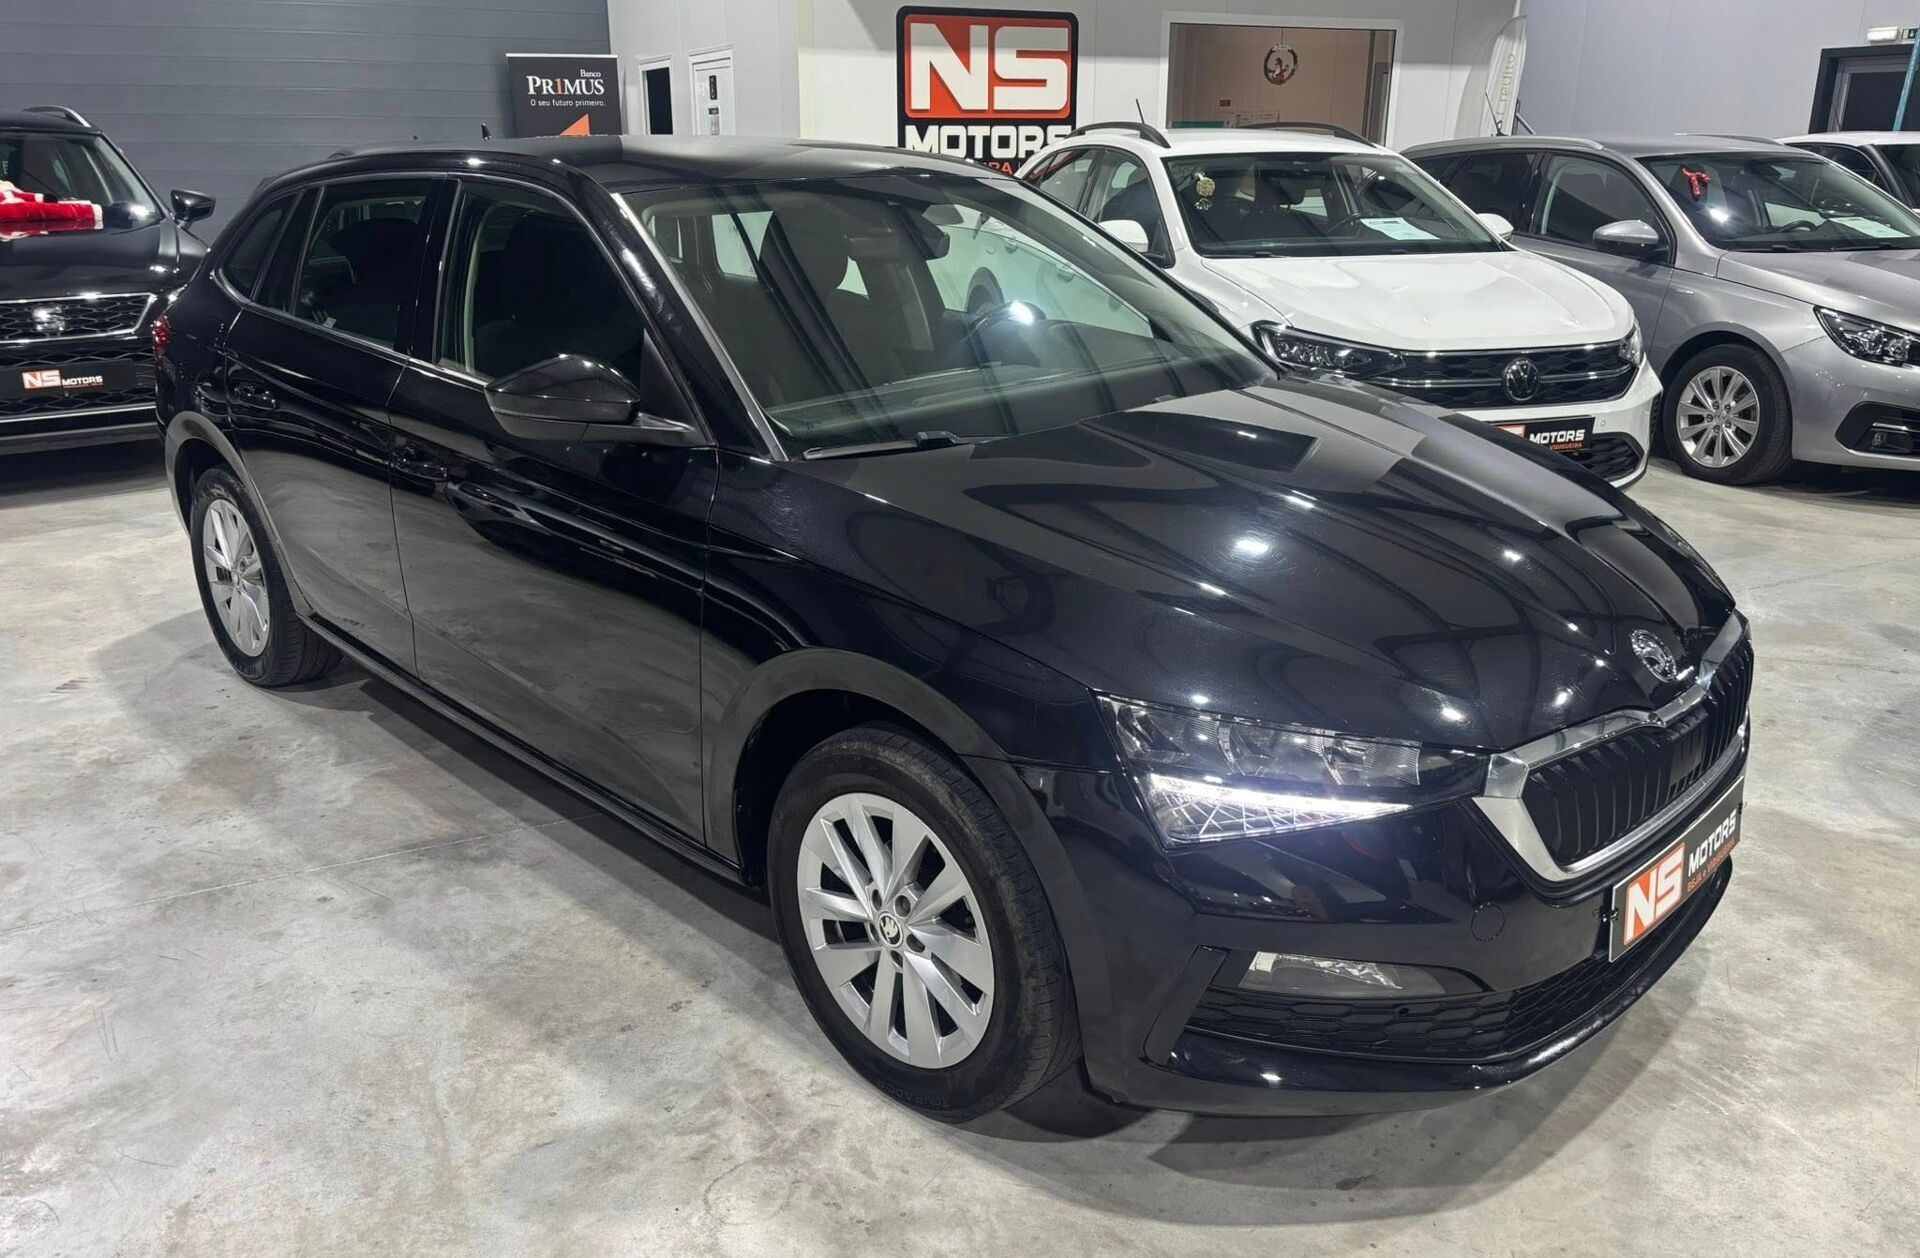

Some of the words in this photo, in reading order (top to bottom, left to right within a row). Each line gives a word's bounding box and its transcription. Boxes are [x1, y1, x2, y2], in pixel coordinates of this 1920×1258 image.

[580, 69, 601, 78] Banco
[910, 22, 1068, 110] NS
[552, 98, 573, 106] futuro
[22, 369, 61, 390] NS
[62, 375, 103, 387] MOTORS
[1529, 428, 1586, 445] MOTORS
[1625, 844, 1685, 942] NS
[1688, 808, 1737, 877] MOTORS
